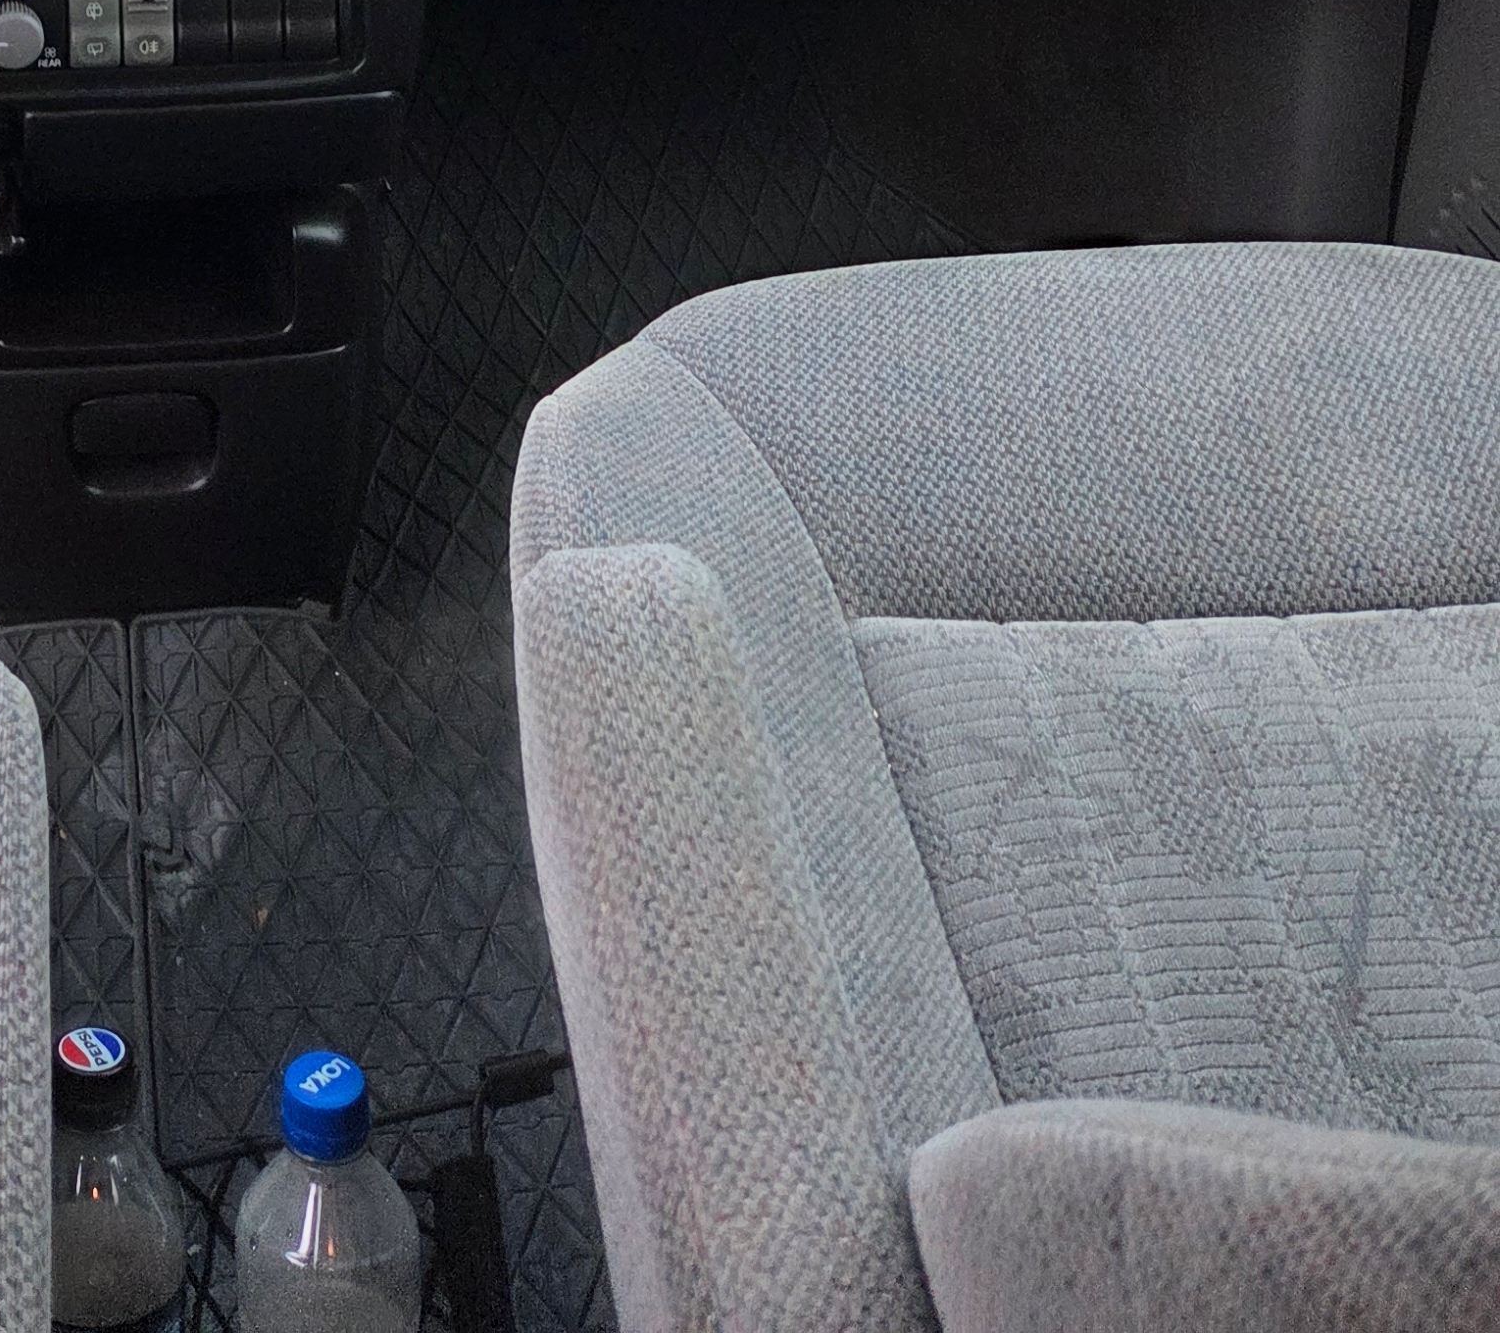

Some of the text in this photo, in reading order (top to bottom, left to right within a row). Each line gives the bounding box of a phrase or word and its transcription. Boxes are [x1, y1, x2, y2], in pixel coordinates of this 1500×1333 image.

[38, 58, 62, 68] REAR
[76, 1030, 108, 1067] PEPSI
[299, 1057, 351, 1094] LOKA
